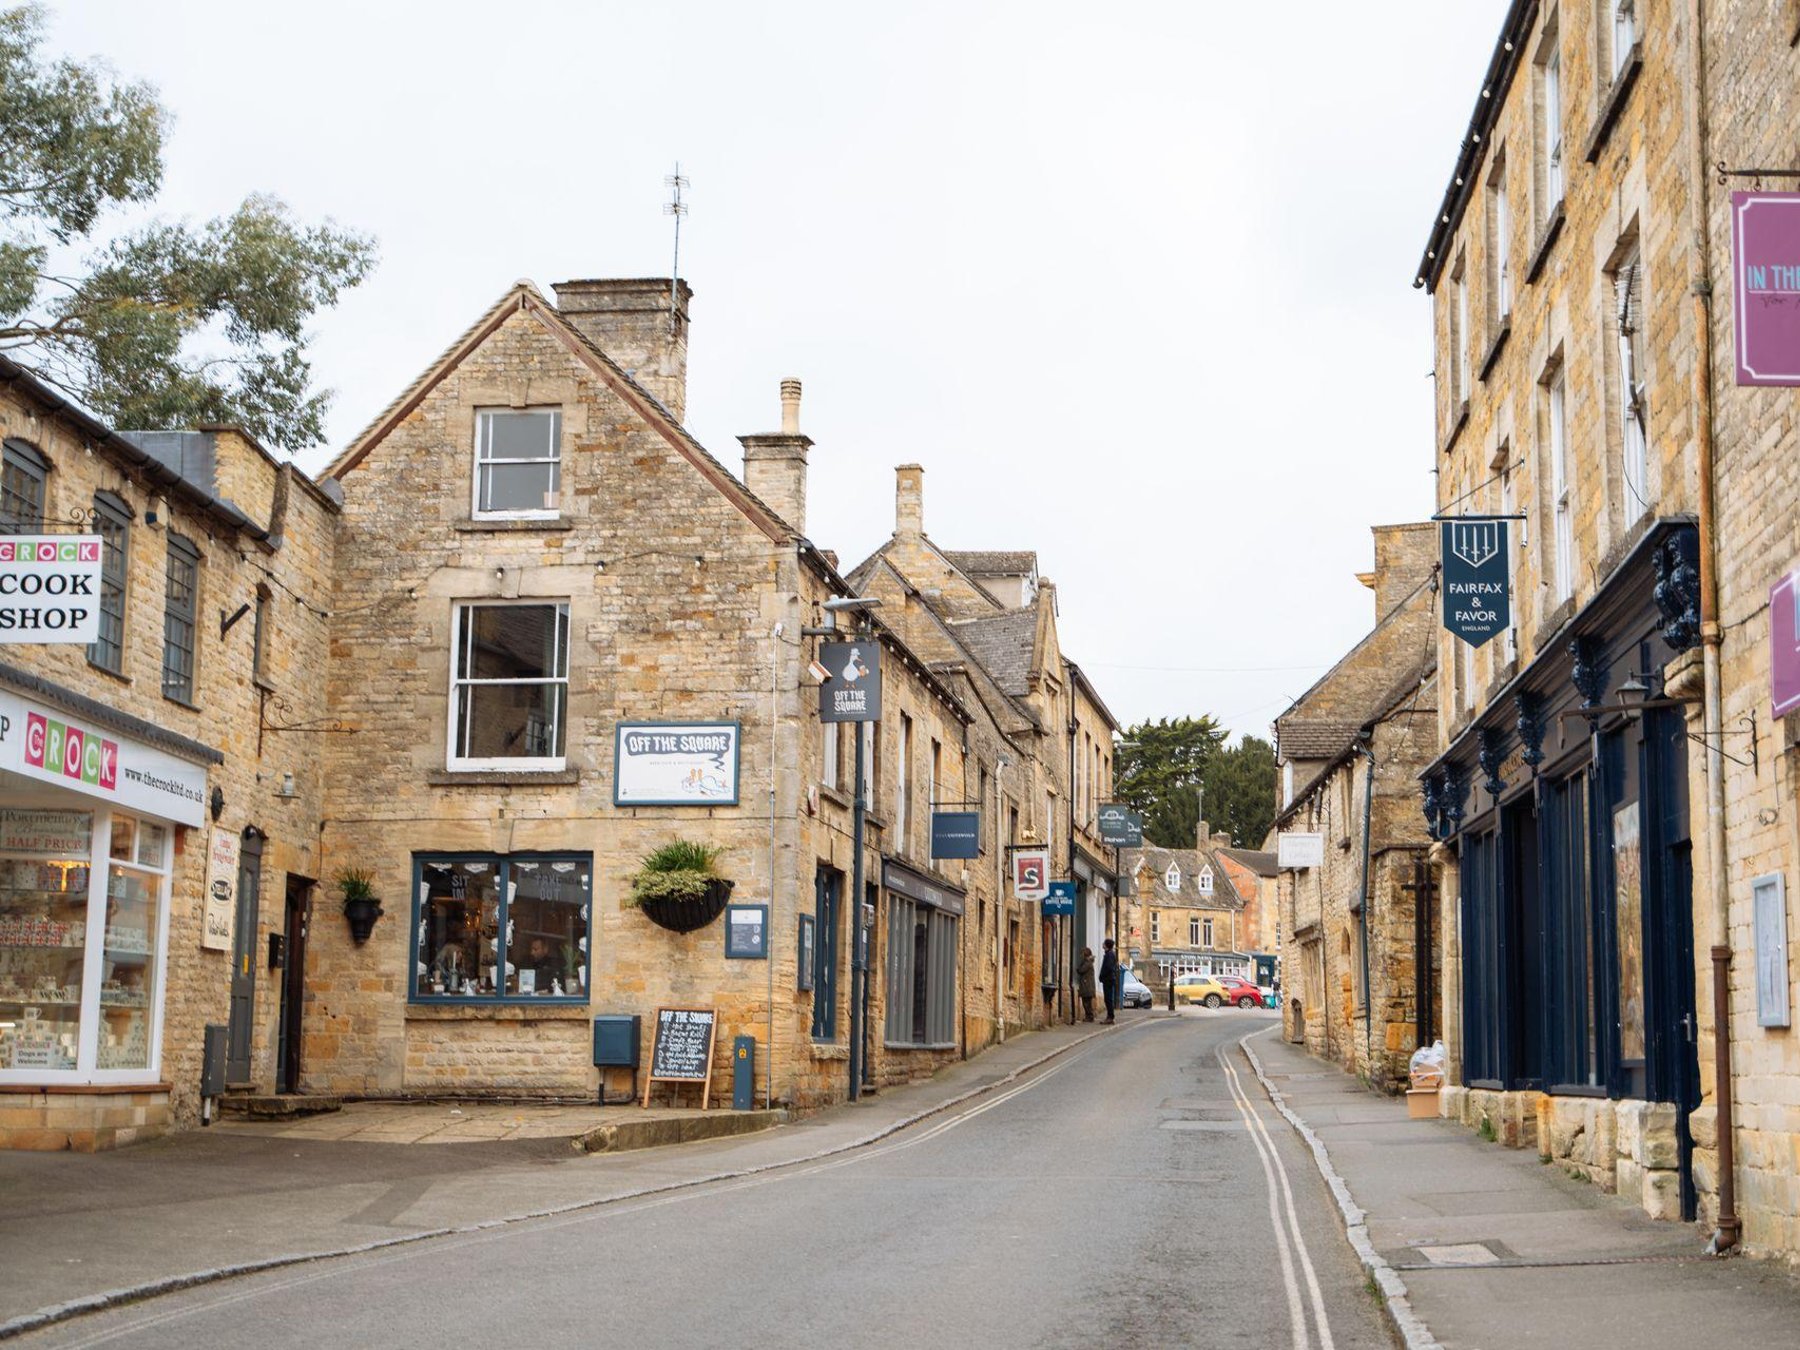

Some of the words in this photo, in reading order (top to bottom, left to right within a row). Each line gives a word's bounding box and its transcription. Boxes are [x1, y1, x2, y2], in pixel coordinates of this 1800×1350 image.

[1747, 265, 1766, 289] IN
[0, 574, 93, 595] COOK
[1449, 583, 1502, 593] FAIRFAX
[1471, 597, 1481, 607] &
[0, 608, 88, 629] SHOP
[1455, 611, 1497, 621] FAVOR
[834, 690, 848, 700] OFF
[849, 690, 866, 700] THE
[834, 701, 866, 712] SQUARE
[629, 736, 651, 752] OFF
[652, 736, 677, 751] THE
[680, 735, 727, 752] SQUARE
[27, 721, 113, 783] CROCK
[125, 768, 203, 803] www.thecrockltd.co.uk
[6, 837, 41, 847] HALF
[45, 838, 83, 849] PRICE
[452, 875, 470, 887] SIT
[452, 888, 465, 900] IN
[540, 887, 561, 900] OUT
[18, 1050, 35, 1058] Dogs
